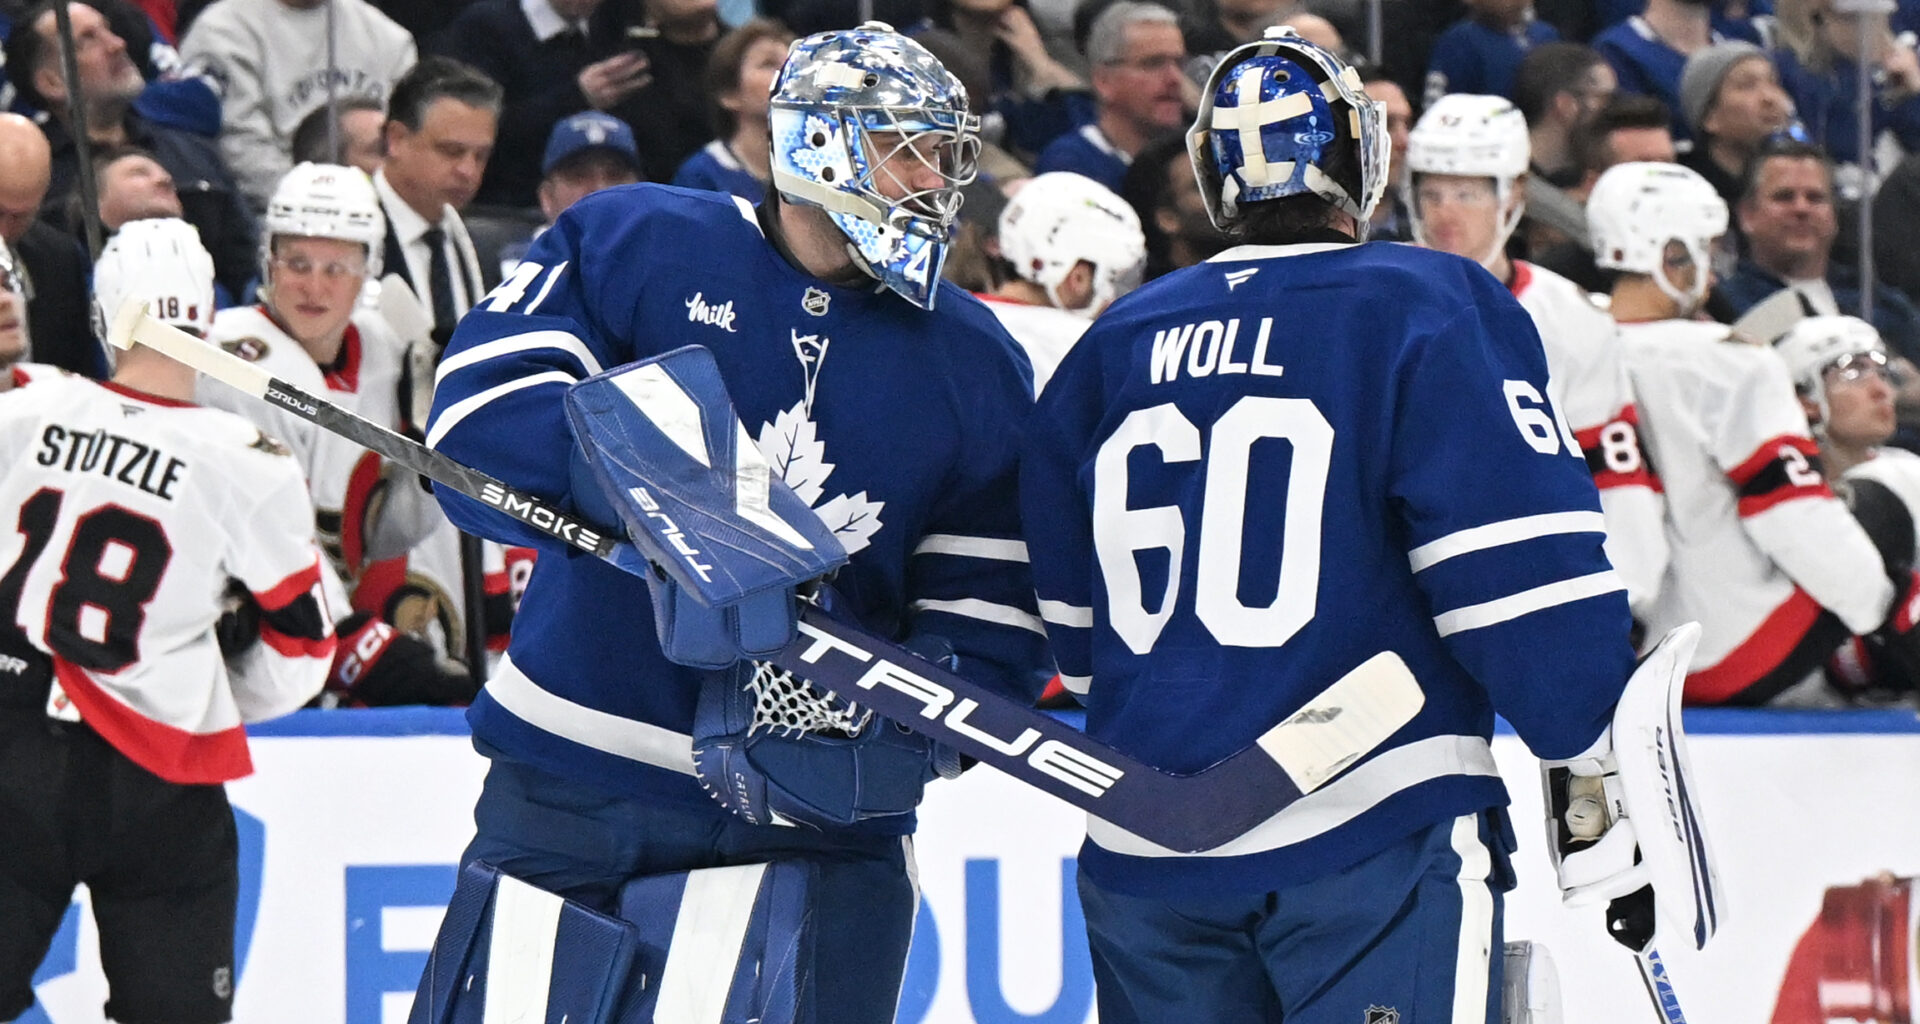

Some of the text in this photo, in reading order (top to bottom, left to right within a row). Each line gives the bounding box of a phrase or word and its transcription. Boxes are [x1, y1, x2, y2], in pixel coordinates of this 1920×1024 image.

[158, 296, 179, 319] 18
[478, 260, 569, 316] 41
[685, 291, 737, 333] Milk
[1150, 317, 1284, 385] WOLL
[1600, 420, 1641, 474] 8
[1777, 444, 1823, 488] 2
[480, 482, 601, 552] SMOKE
[627, 486, 713, 584] TRUE
[1093, 395, 1336, 656] 60
[0, 485, 174, 676] 18
[797, 619, 1126, 799] TRUE
[1655, 725, 1685, 844] BAUER
